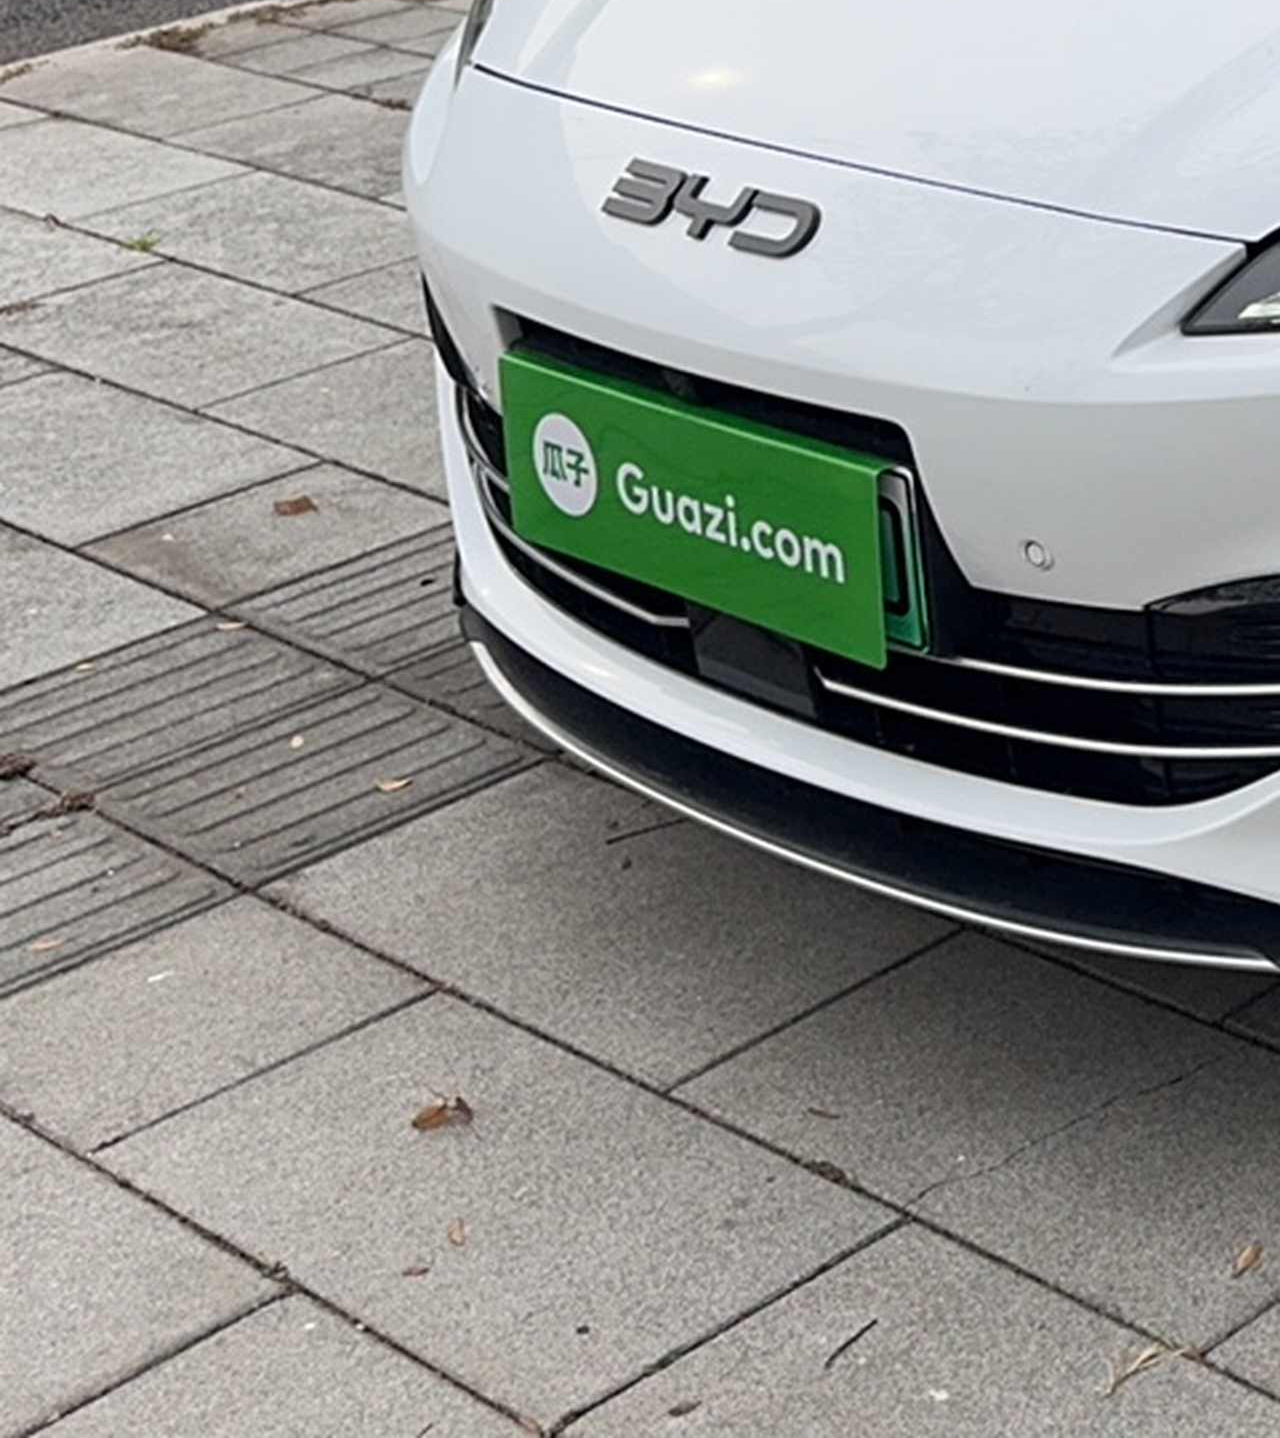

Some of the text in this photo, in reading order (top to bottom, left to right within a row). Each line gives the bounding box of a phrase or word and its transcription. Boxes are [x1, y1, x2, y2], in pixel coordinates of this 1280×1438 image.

[602, 158, 821, 259] BYD
[542, 440, 590, 487] 瓜子
[615, 462, 845, 583] Guazi.com
